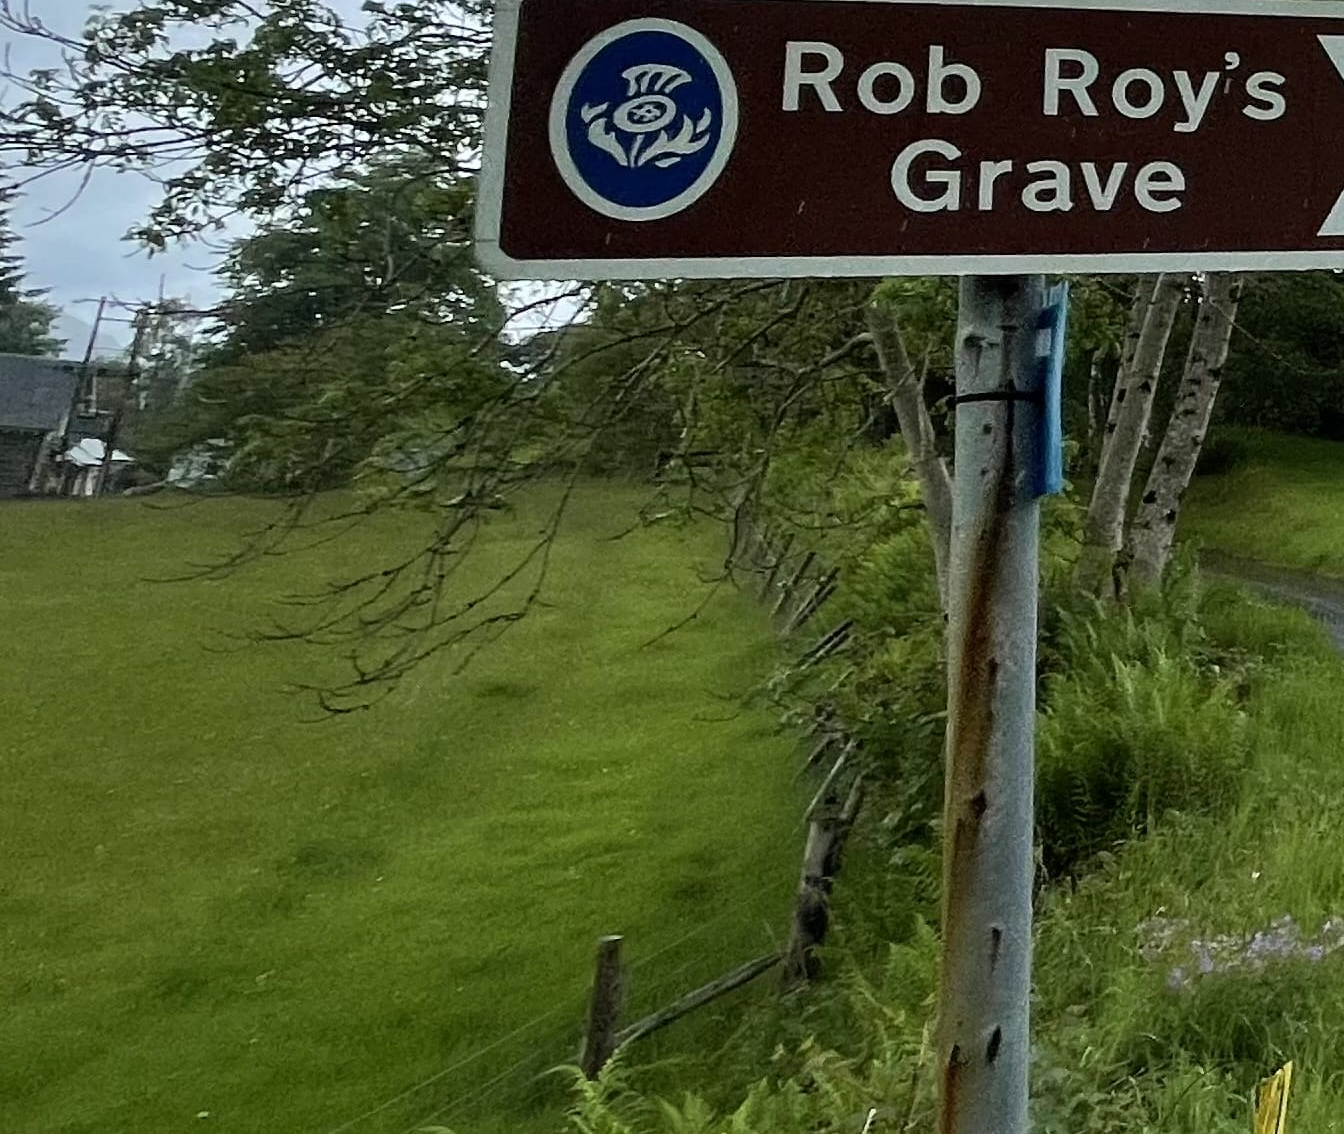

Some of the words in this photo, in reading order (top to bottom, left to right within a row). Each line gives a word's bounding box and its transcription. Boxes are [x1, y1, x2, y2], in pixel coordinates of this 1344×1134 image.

[781, 40, 982, 116] Rob
[1042, 47, 1287, 134] Roy's
[889, 137, 1187, 214] Grave
